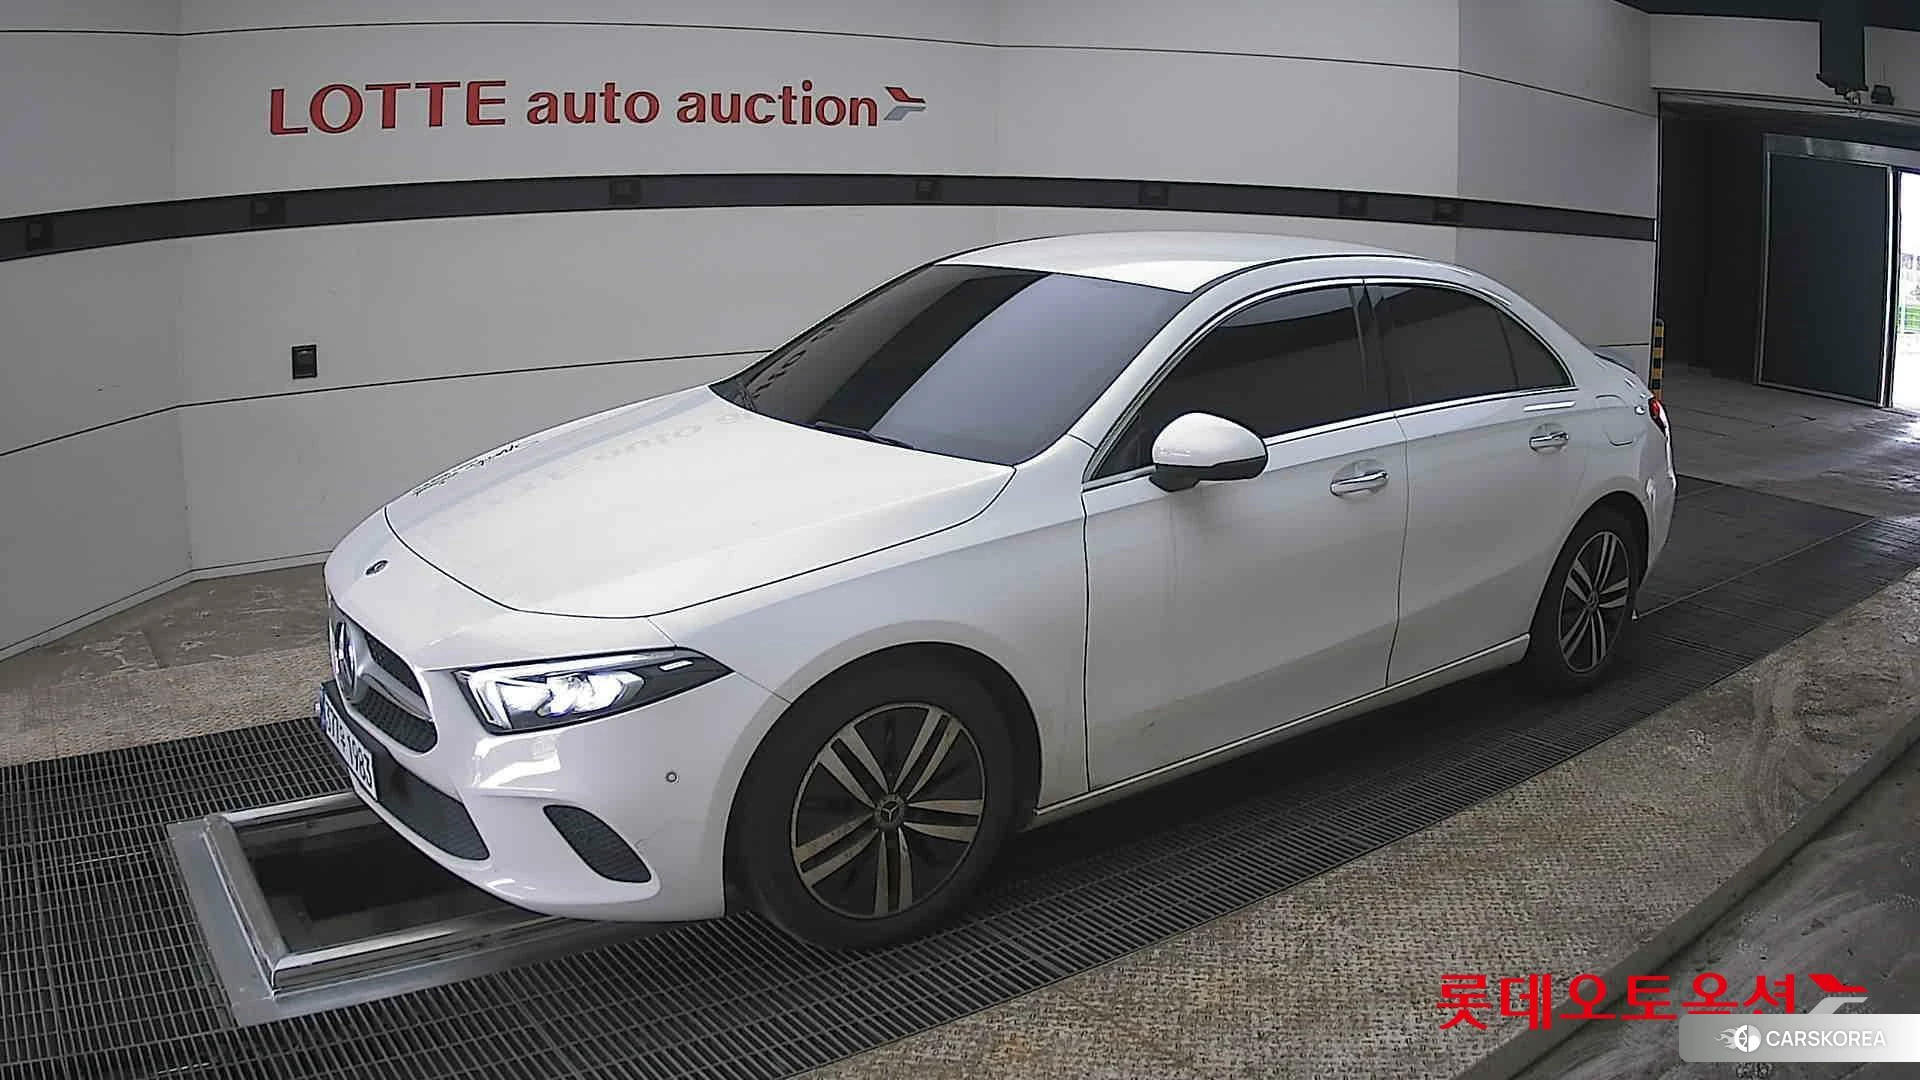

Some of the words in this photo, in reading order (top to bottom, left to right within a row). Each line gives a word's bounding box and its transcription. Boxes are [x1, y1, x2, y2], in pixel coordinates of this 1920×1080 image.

[270, 80, 507, 136] LOTTE
[526, 81, 661, 125] auto
[677, 80, 878, 126] auction
